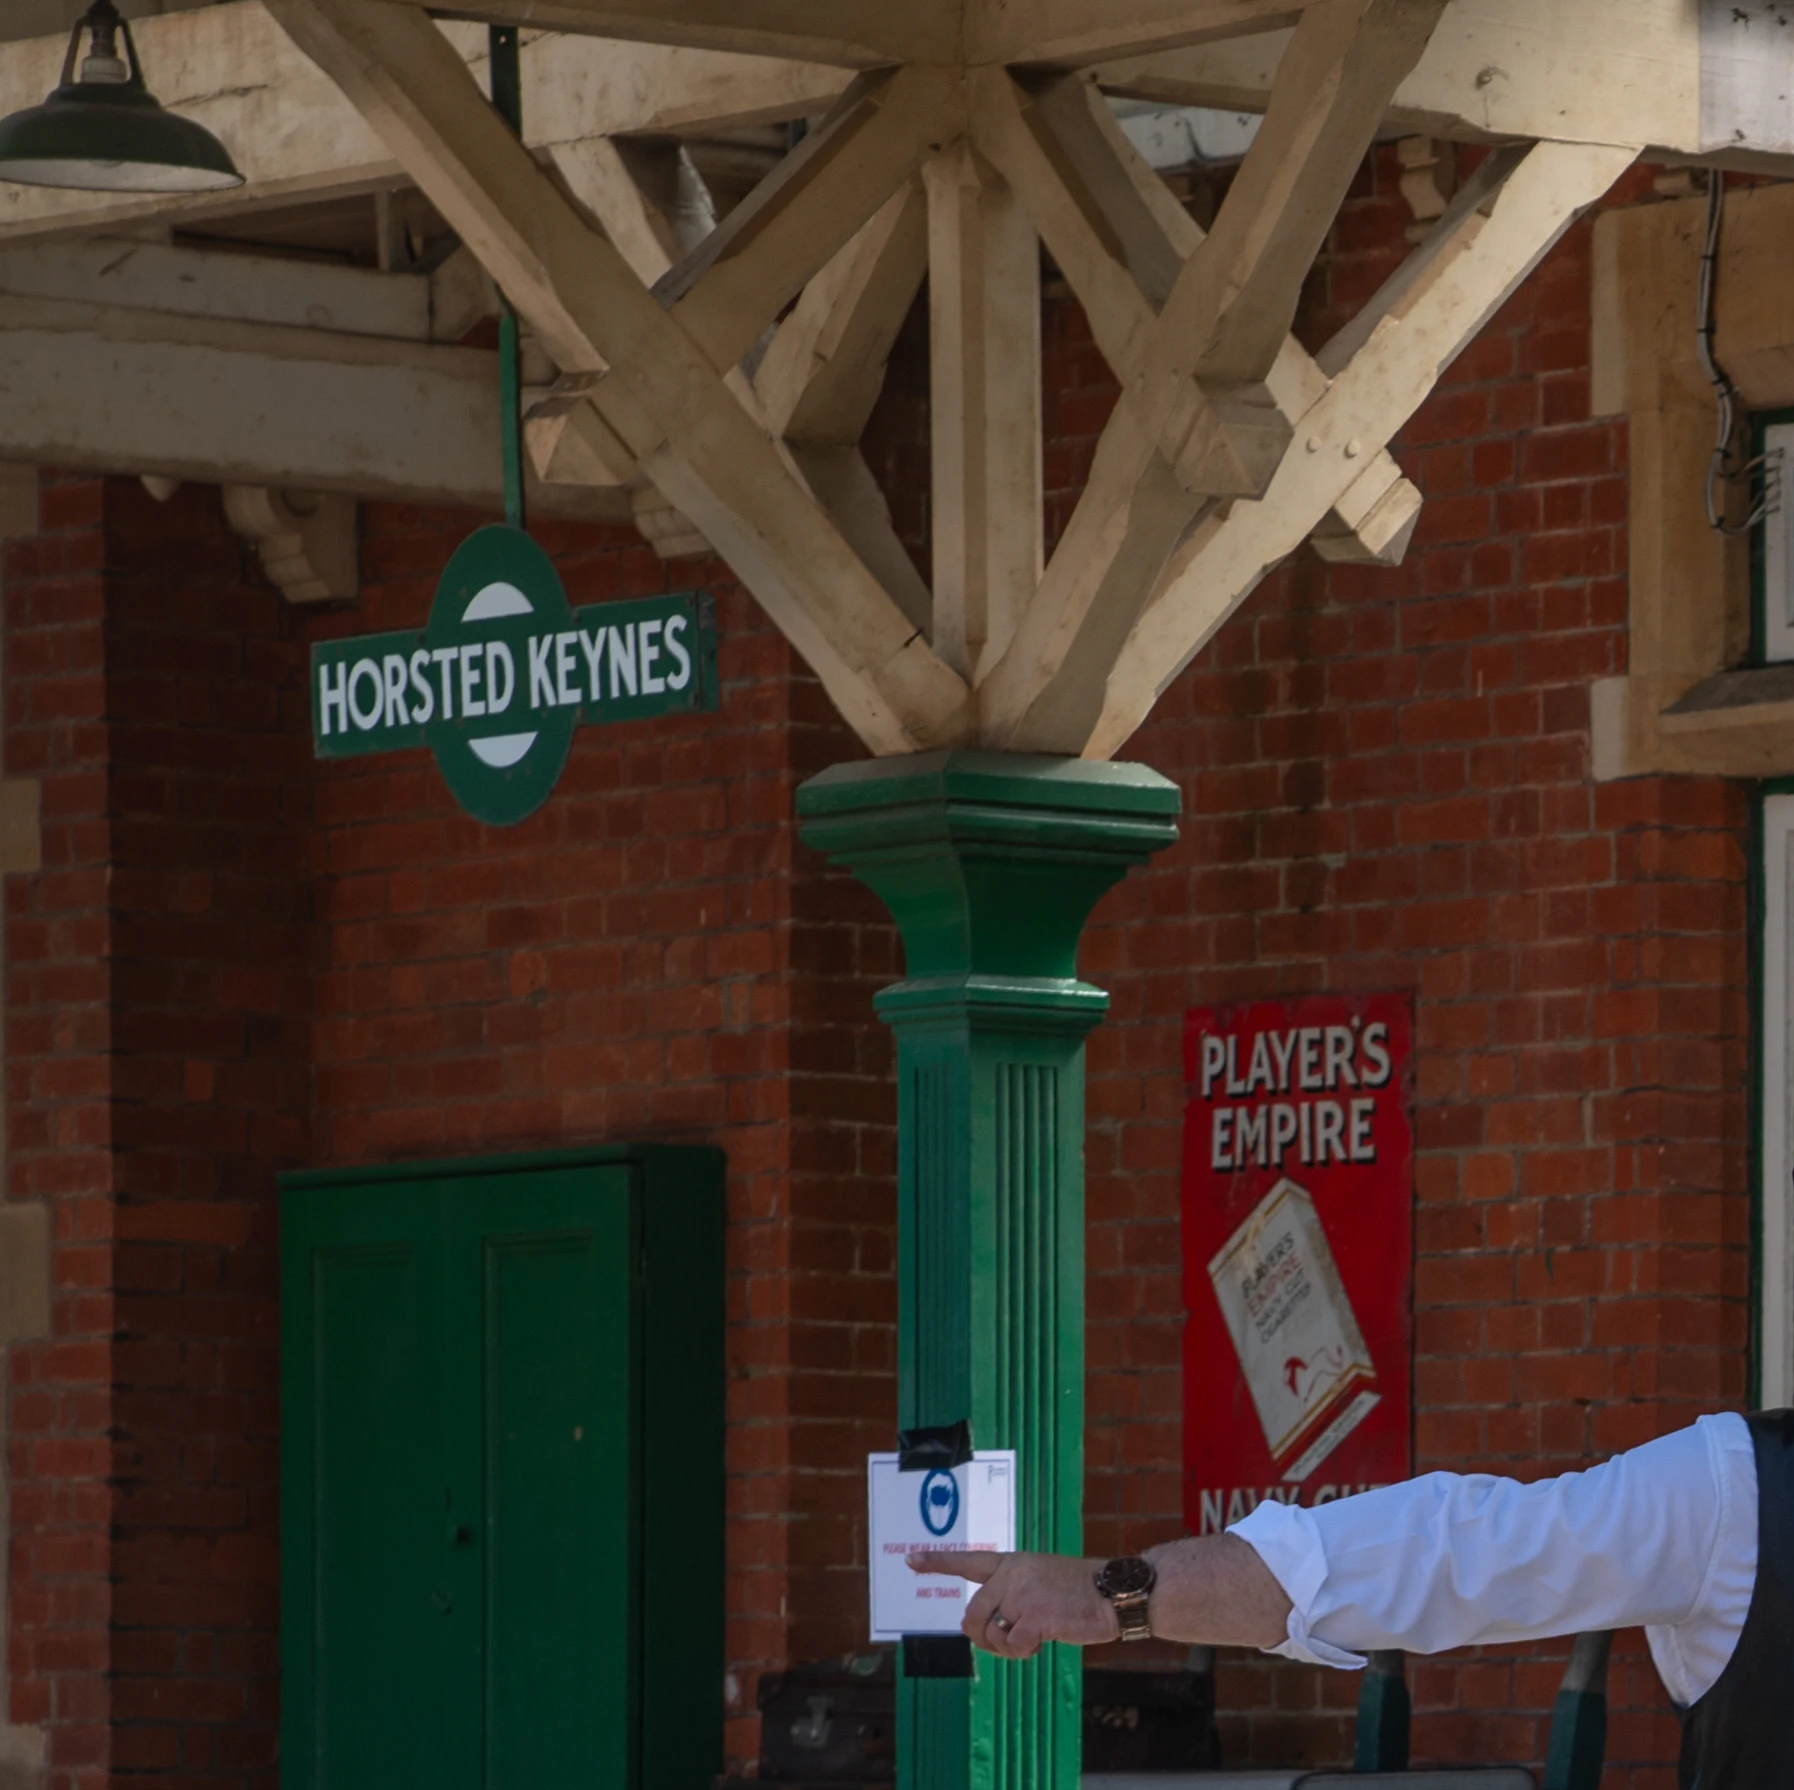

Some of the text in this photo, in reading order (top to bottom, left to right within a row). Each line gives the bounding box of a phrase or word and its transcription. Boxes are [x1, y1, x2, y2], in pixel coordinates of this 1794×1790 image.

[319, 613, 692, 736] HORSTED KEYNES
[1201, 1015, 1392, 1098] PLAYER'S
[1211, 1098, 1378, 1170] EMPIRE
